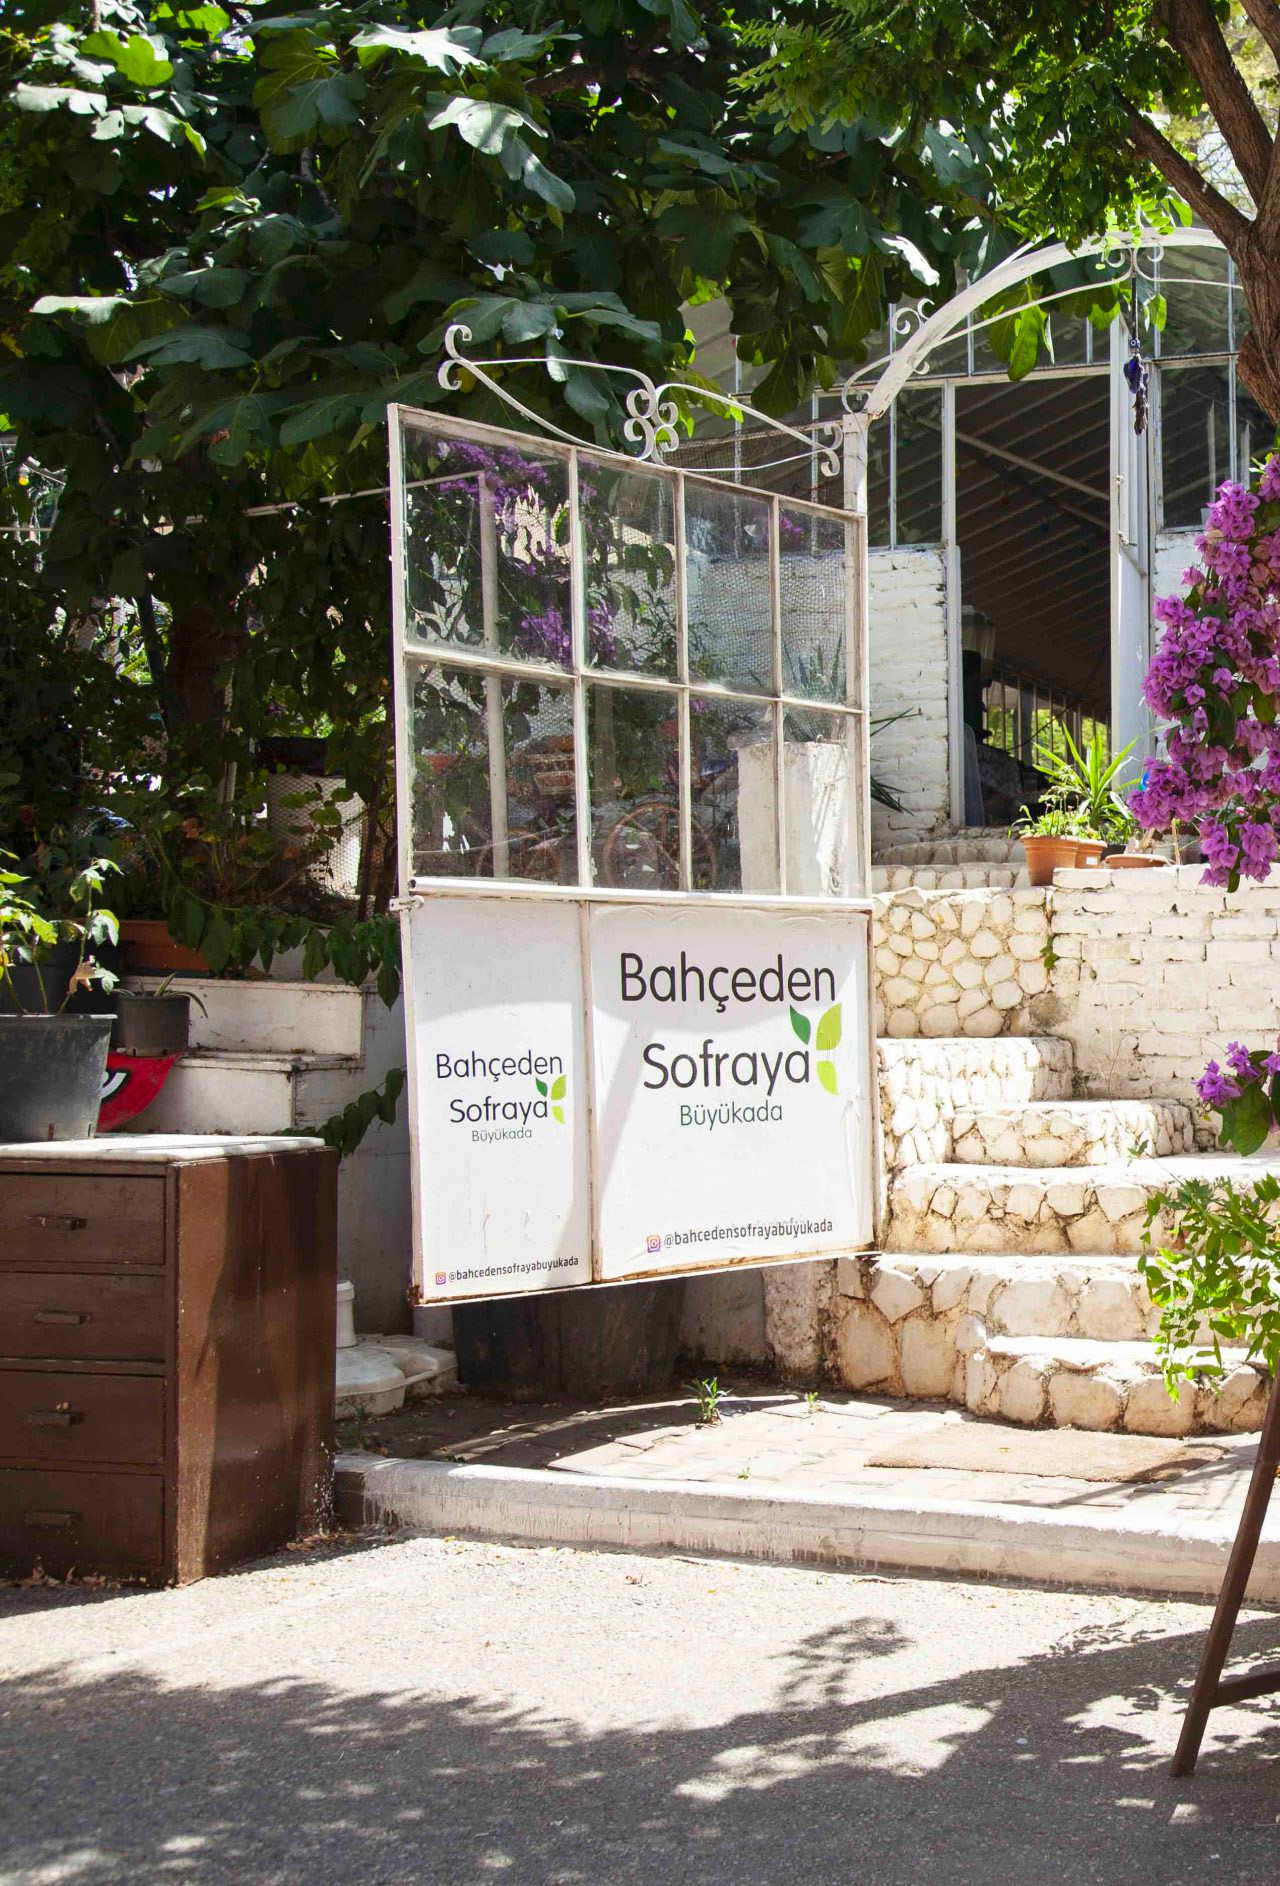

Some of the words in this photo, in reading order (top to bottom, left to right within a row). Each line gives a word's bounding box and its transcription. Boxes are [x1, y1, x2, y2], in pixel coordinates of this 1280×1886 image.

[620, 951, 836, 1013] Bahçeden
[436, 1049, 563, 1083] Bahçeden
[643, 1039, 810, 1097] Sofraya
[449, 1095, 548, 1126] Sofraya
[679, 1099, 783, 1131] Büyükada
[471, 1126, 533, 1145] Büyükada
[663, 1217, 834, 1249] @bahcedensofrayabuyukada
[448, 1255, 579, 1283] @bahcedensofrayabuyukada
